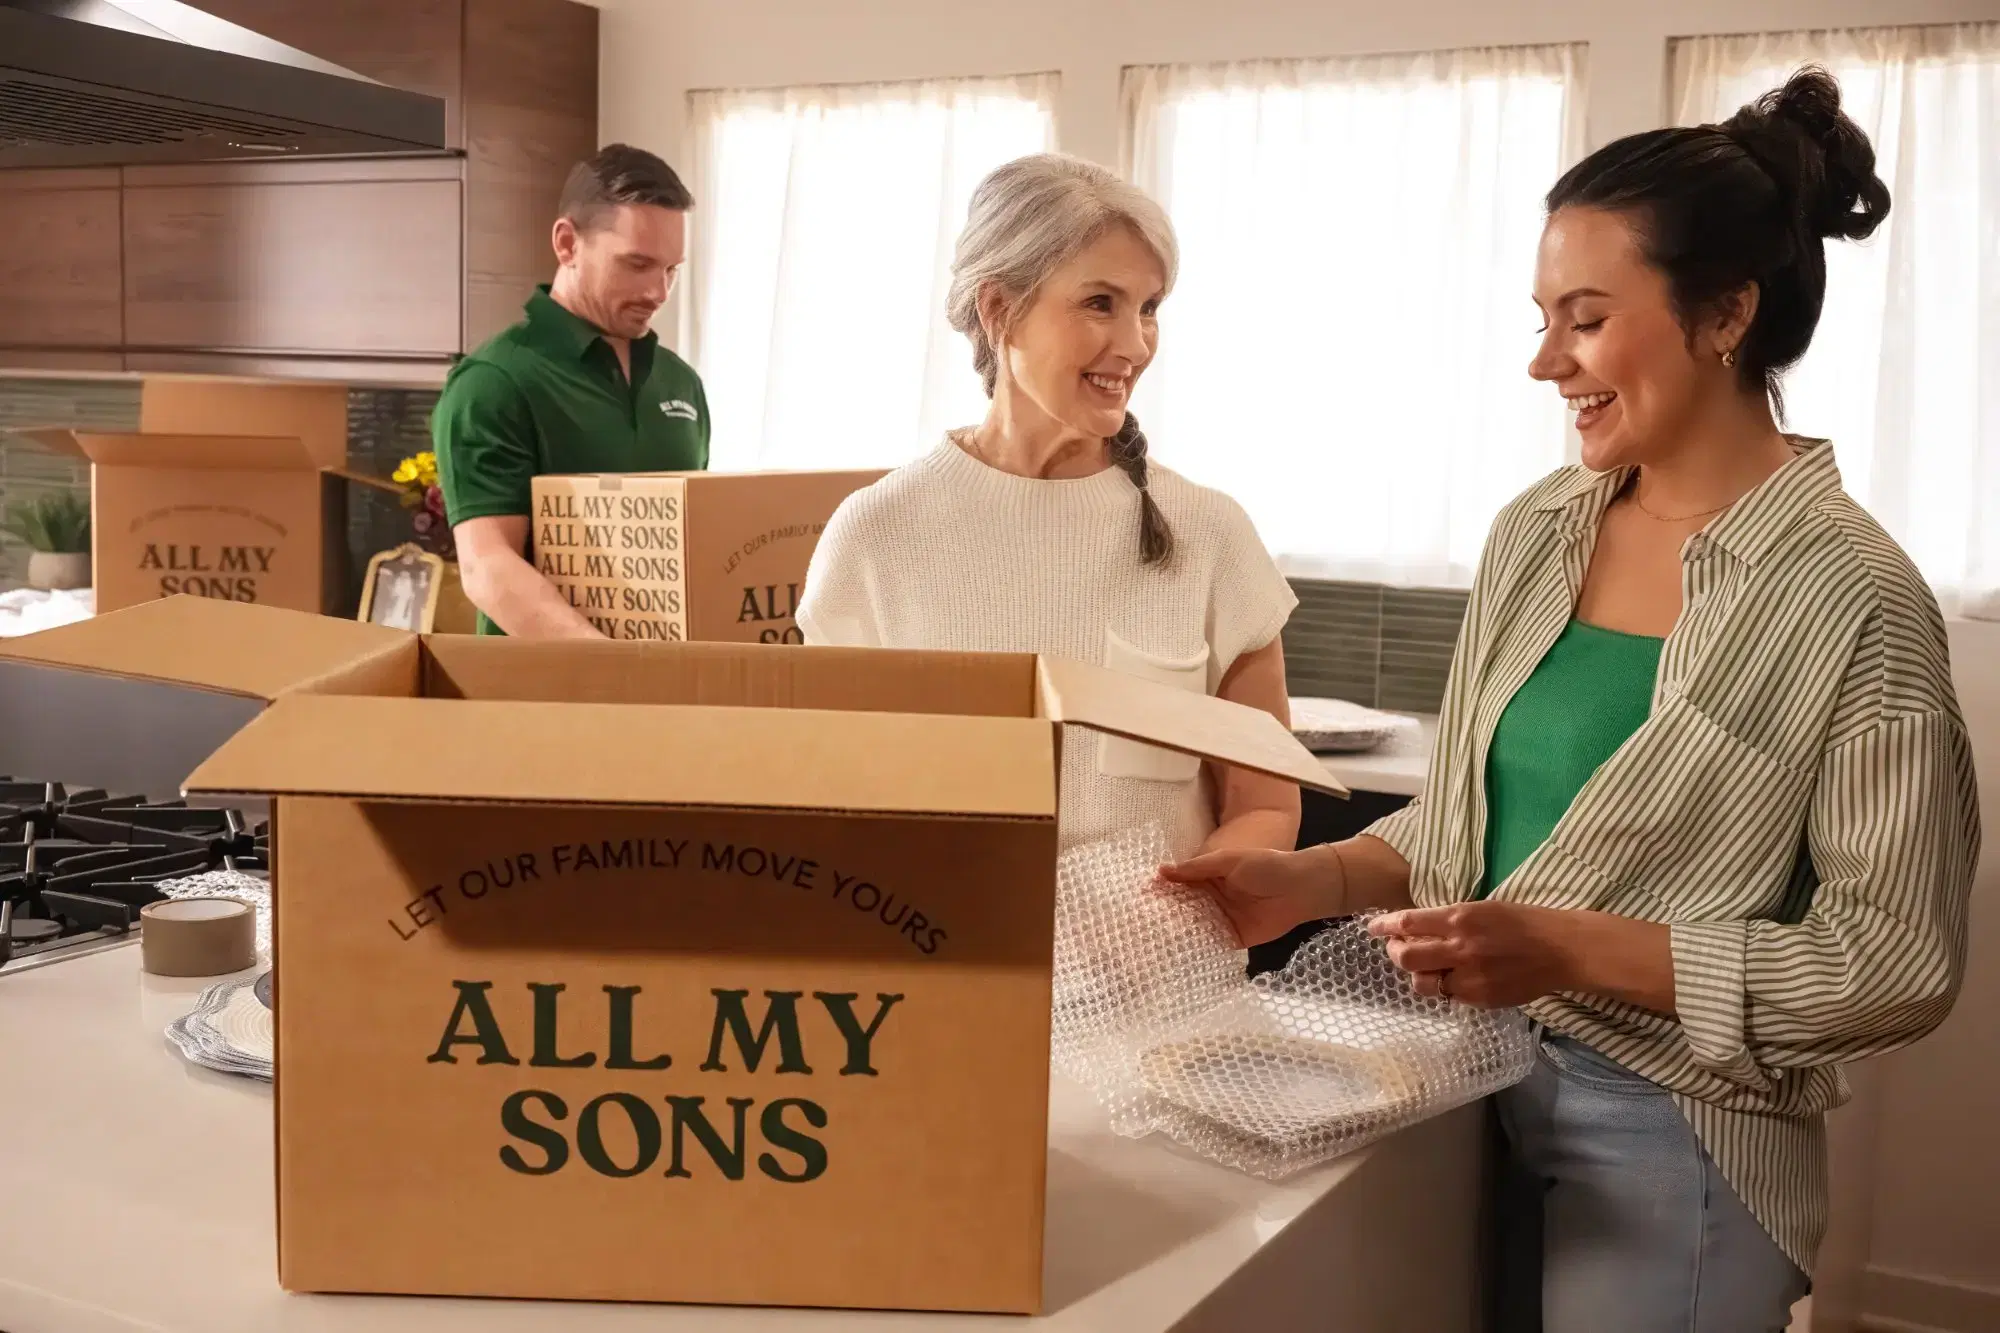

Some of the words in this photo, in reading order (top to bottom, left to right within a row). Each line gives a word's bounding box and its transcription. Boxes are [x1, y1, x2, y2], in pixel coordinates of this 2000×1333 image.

[540, 496, 578, 518] ALL
[583, 496, 615, 518] MY
[620, 496, 677, 520] SONS
[540, 524, 579, 546] ALL
[584, 525, 616, 547] MY
[621, 526, 678, 550] SONS
[138, 543, 211, 572] ALL
[218, 546, 275, 573] MY
[541, 553, 580, 576] ALL
[585, 555, 617, 578] MY
[622, 556, 679, 581] SONS
[723, 551, 741, 575] LET
[743, 534, 768, 556] OUR
[160, 575, 257, 604] SONS
[586, 585, 618, 609] MY
[623, 587, 680, 613] SONS
[624, 618, 681, 641] SONS
[388, 884, 447, 941] LET
[459, 852, 540, 899] OUR
[551, 838, 689, 876] FAMILY
[702, 841, 820, 890] MOVE
[832, 869, 947, 954] YOURS
[427, 980, 672, 1070] ALL
[700, 988, 904, 1076] MY
[500, 1090, 827, 1182] SONS
